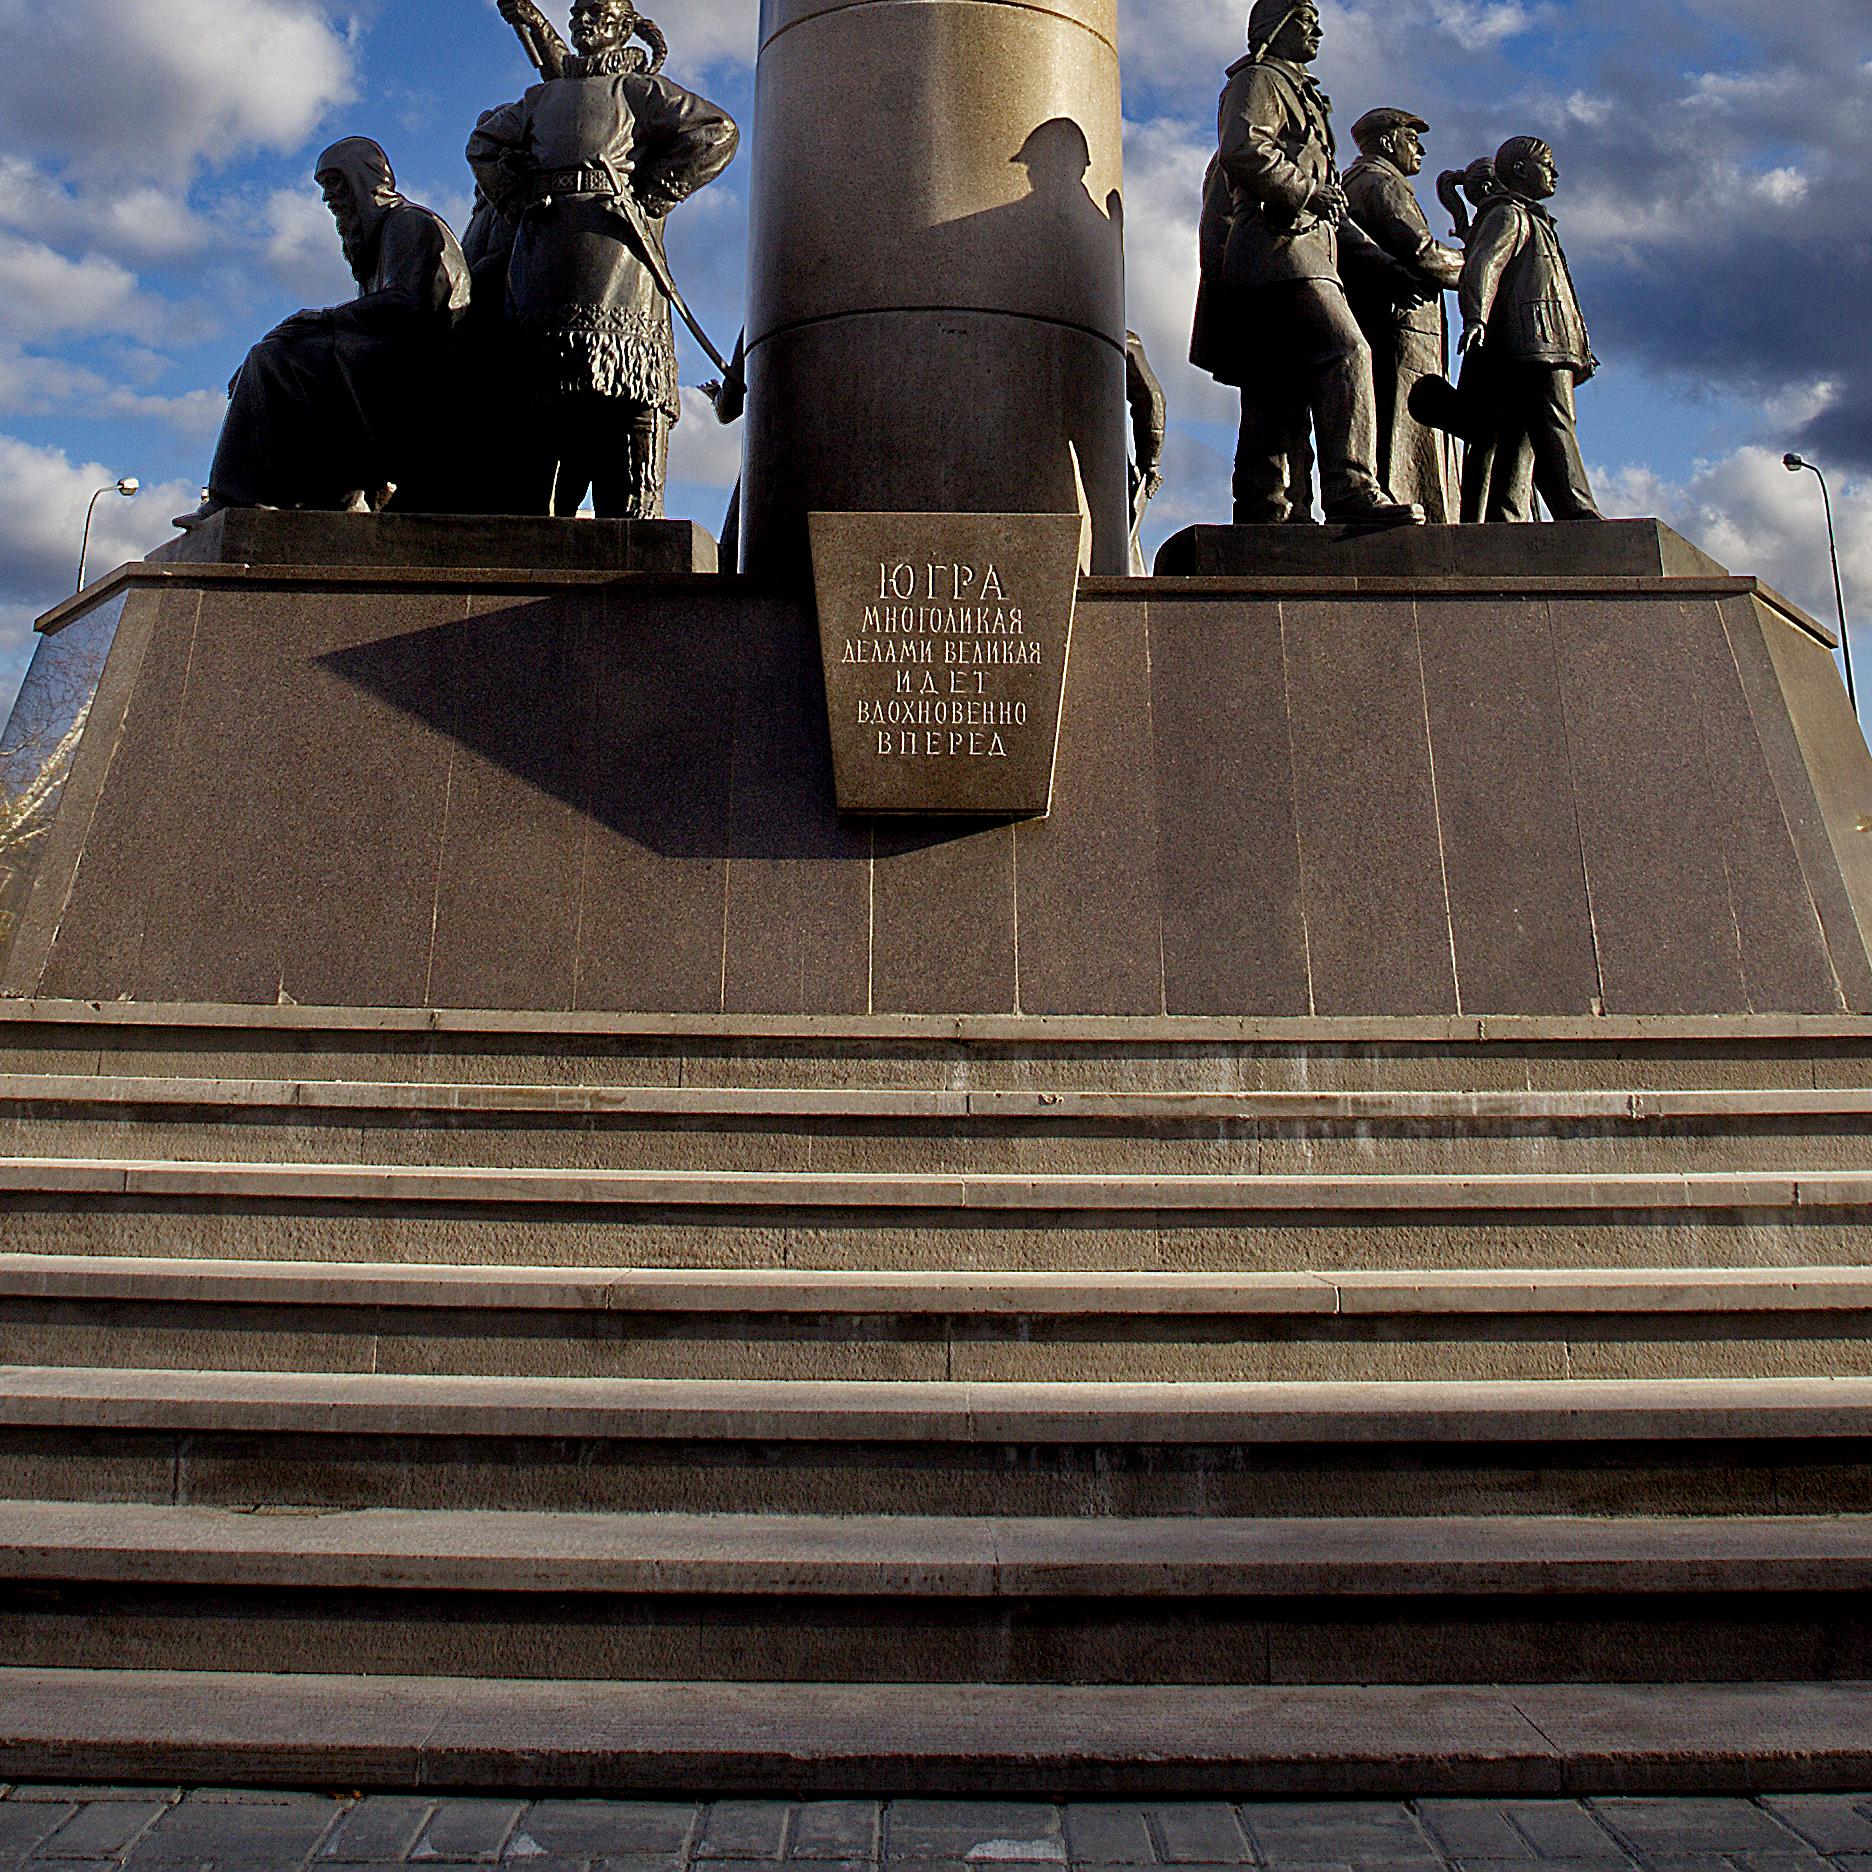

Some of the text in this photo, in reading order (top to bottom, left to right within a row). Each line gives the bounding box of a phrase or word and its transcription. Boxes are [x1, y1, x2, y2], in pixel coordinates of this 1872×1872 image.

[879, 562, 1009, 600] ЮГРА
[861, 606, 1024, 635] МНОГОЛИКАЯ
[841, 639, 1043, 665] ДЕЛАМИ ВЕЛИКАЯ
[895, 669, 992, 695] ИДЕТ
[857, 699, 1028, 726] ВДОХНОВЕННО
[877, 730, 1008, 757] ВПЕРЕД
